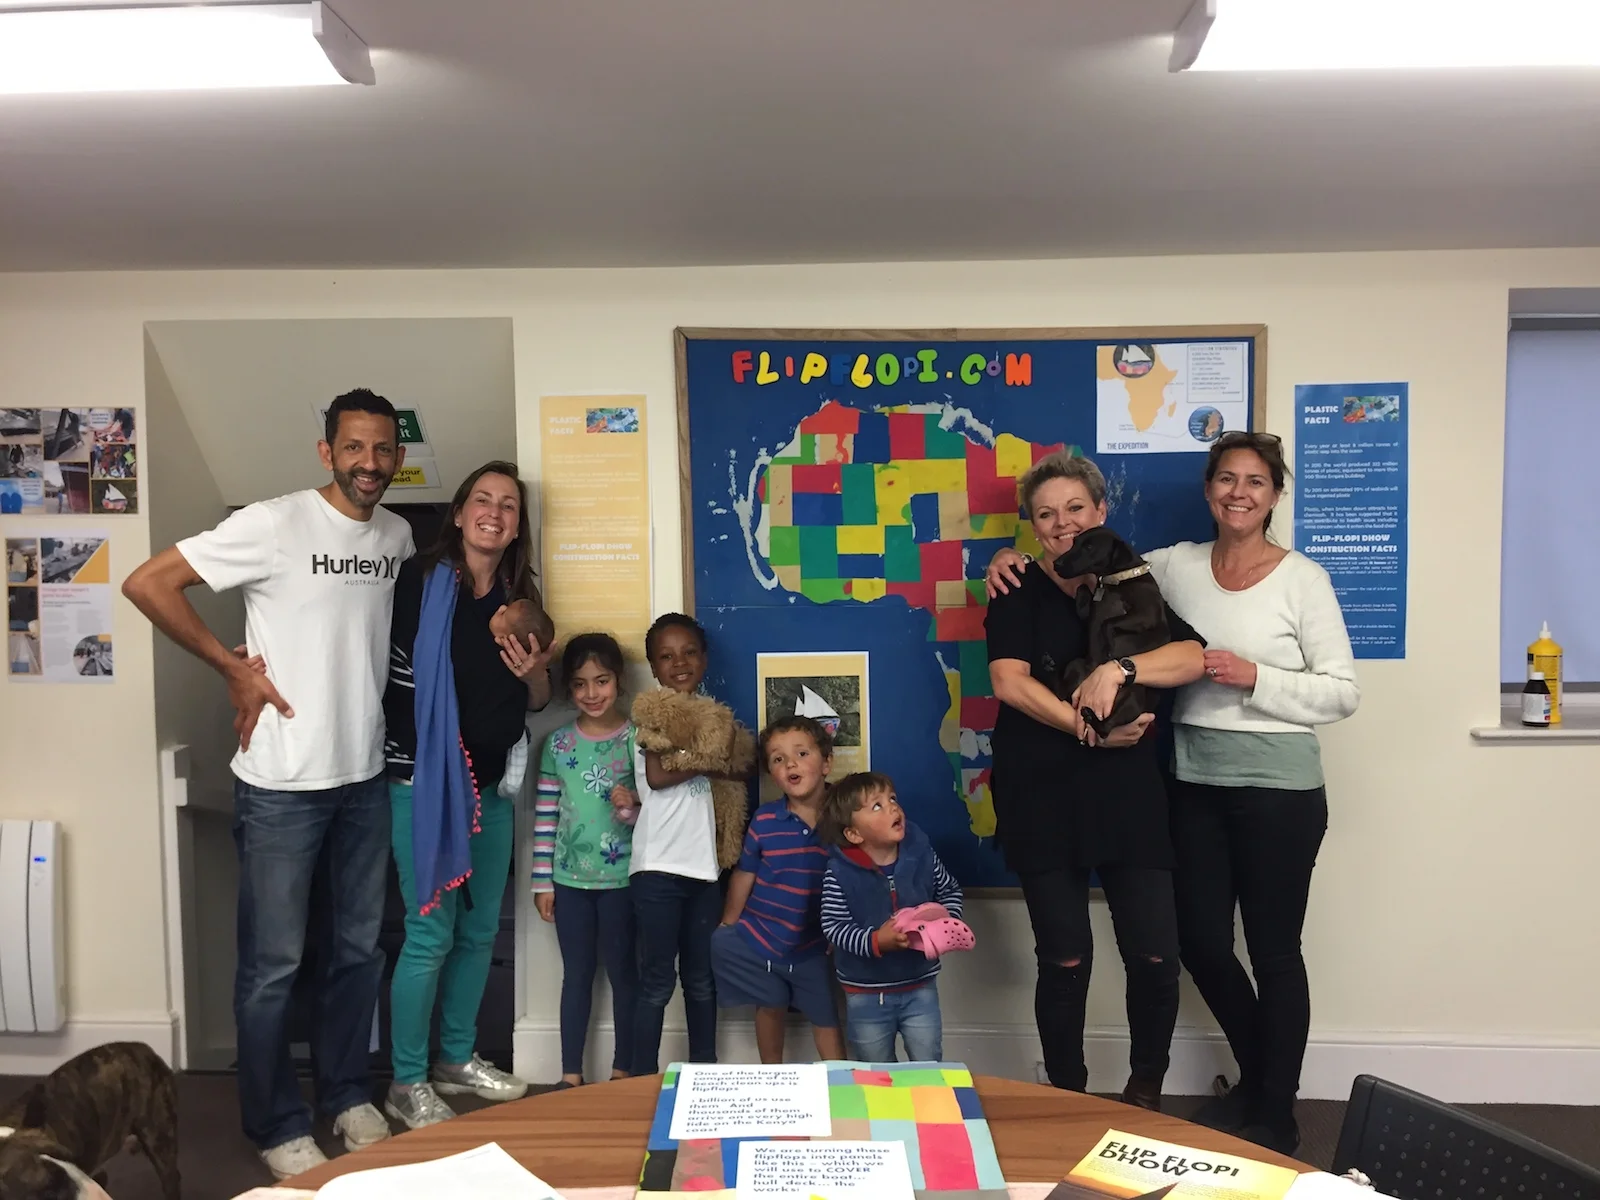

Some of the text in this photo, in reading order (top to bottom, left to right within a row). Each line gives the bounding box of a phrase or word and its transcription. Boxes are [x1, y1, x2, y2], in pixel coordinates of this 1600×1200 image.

[312, 555, 382, 577] Hurley
[1098, 1149, 1190, 1176] DHOW
[1106, 1142, 1156, 1157] FLIP
[1164, 1156, 1239, 1176] FLOPI
